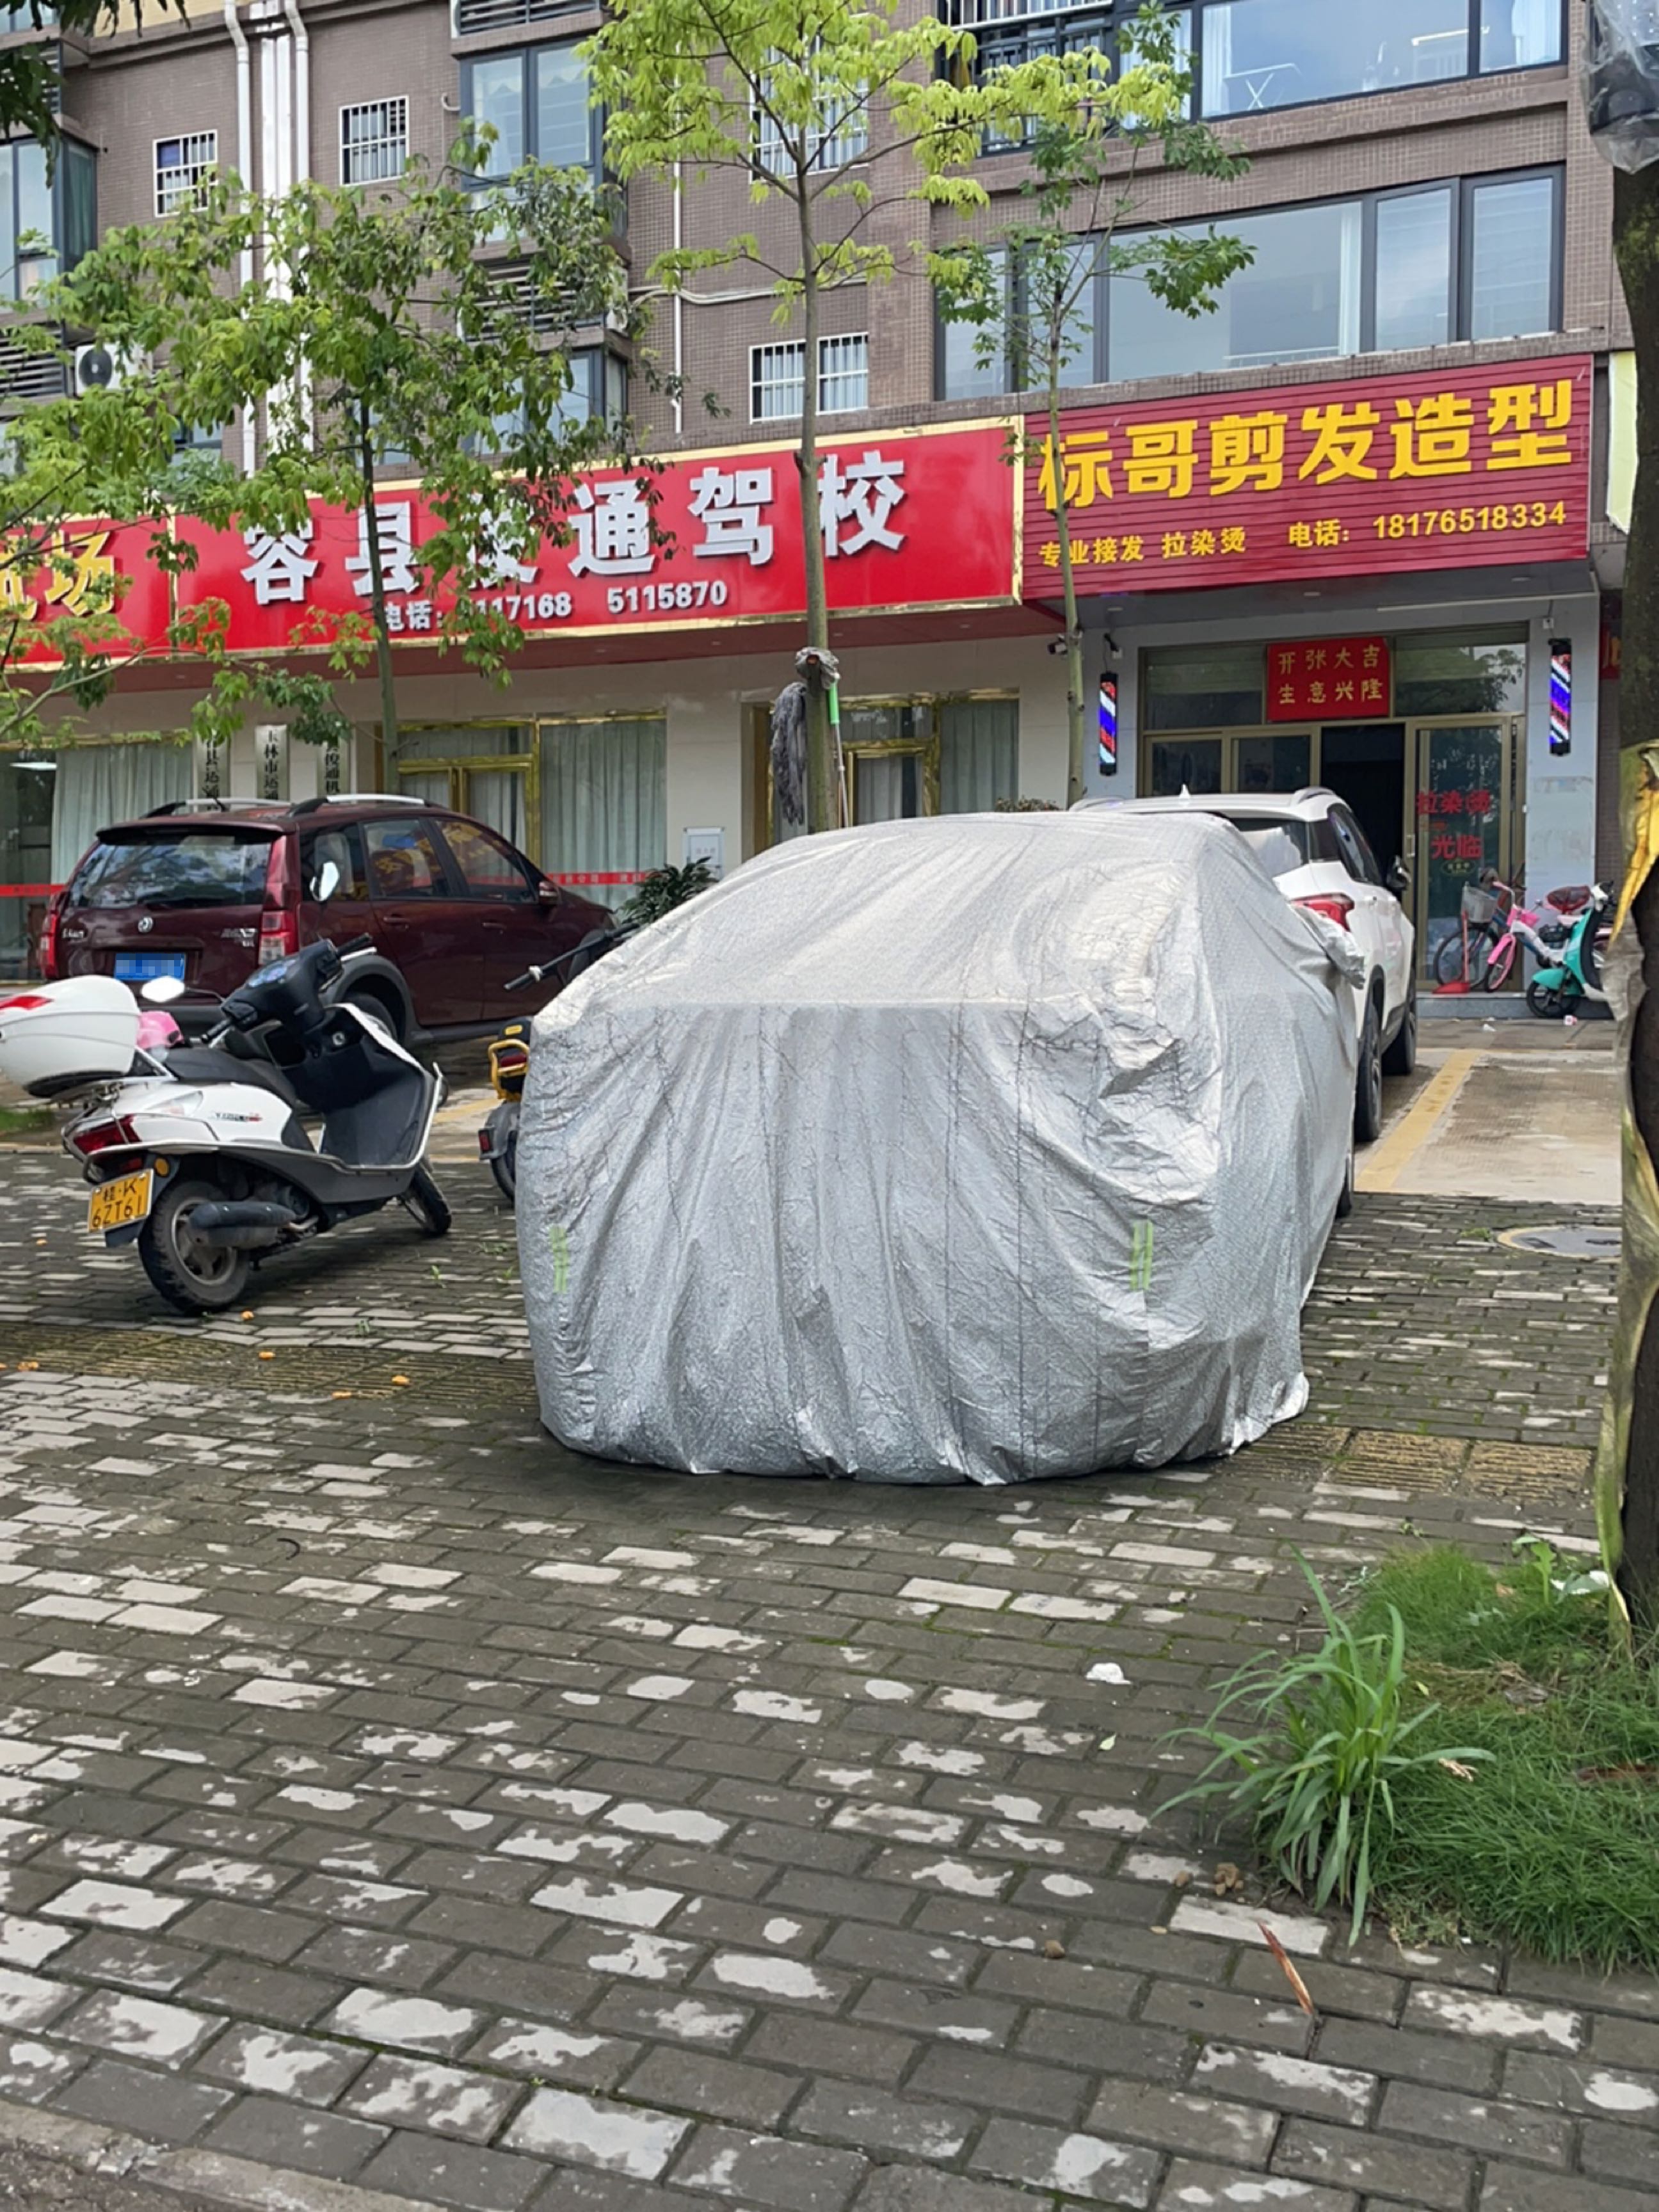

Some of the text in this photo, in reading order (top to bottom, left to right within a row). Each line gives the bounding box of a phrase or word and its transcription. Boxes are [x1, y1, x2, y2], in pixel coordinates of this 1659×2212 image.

[1038, 379, 1573, 512] 标哥剪发造型
[1039, 534, 1144, 568] 专业接发
[1162, 525, 1246, 559] 拉染烫
[1372, 501, 1567, 541] 18176518334
[458, 591, 572, 622] 117168
[606, 580, 728, 615] 5115870
[1278, 643, 1381, 675] 开张大吉
[1278, 678, 1383, 705] 生意兴隆
[1431, 834, 1482, 860] 光临
